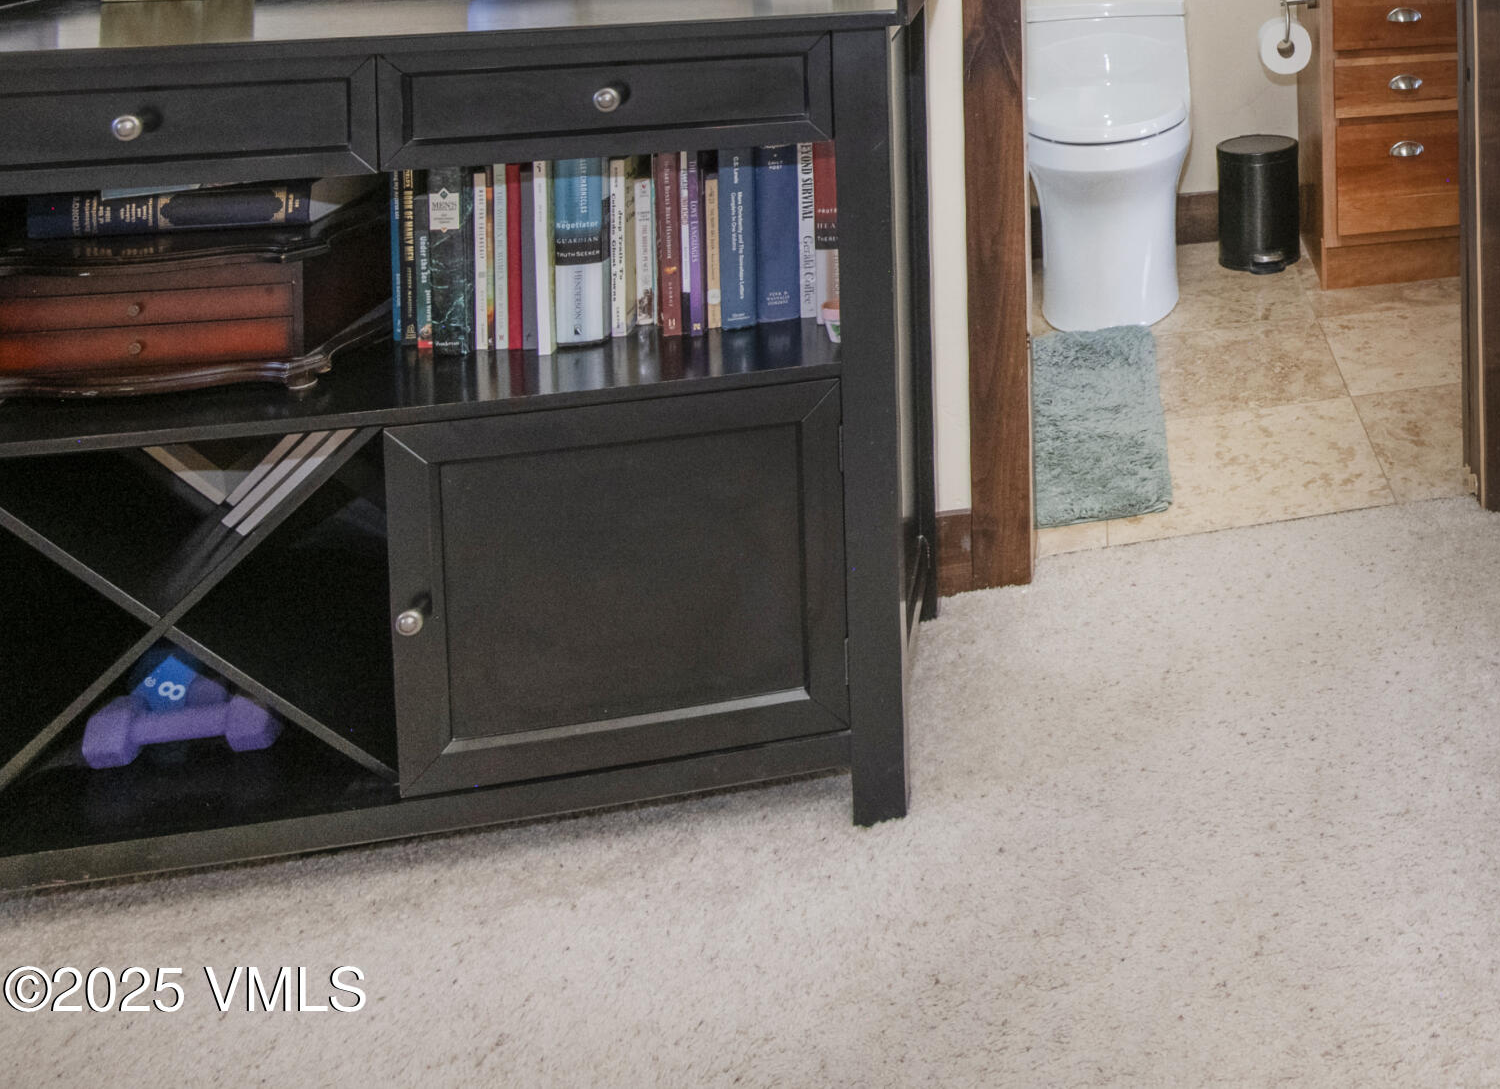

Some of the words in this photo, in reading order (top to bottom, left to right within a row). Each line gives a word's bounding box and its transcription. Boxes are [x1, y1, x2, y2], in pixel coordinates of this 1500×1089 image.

[403, 190, 414, 209] BOOK
[579, 175, 588, 214] CHRONICLES
[801, 177, 814, 222] SURVIVAL
[404, 210, 414, 220] OF
[690, 200, 699, 218] LOVE
[404, 220, 414, 245] MANLY
[556, 221, 599, 231] Negotiator
[419, 235, 428, 257] Under
[556, 236, 599, 245] GUARDIAN
[690, 220, 700, 262] LANGUAGES
[404, 245, 415, 261] MEN
[802, 235, 815, 270] Gerald
[420, 258, 428, 270] the
[573, 270, 583, 320] HENDERSON
[803, 272, 816, 305] Coffee
[158, 681, 186, 701] 8
